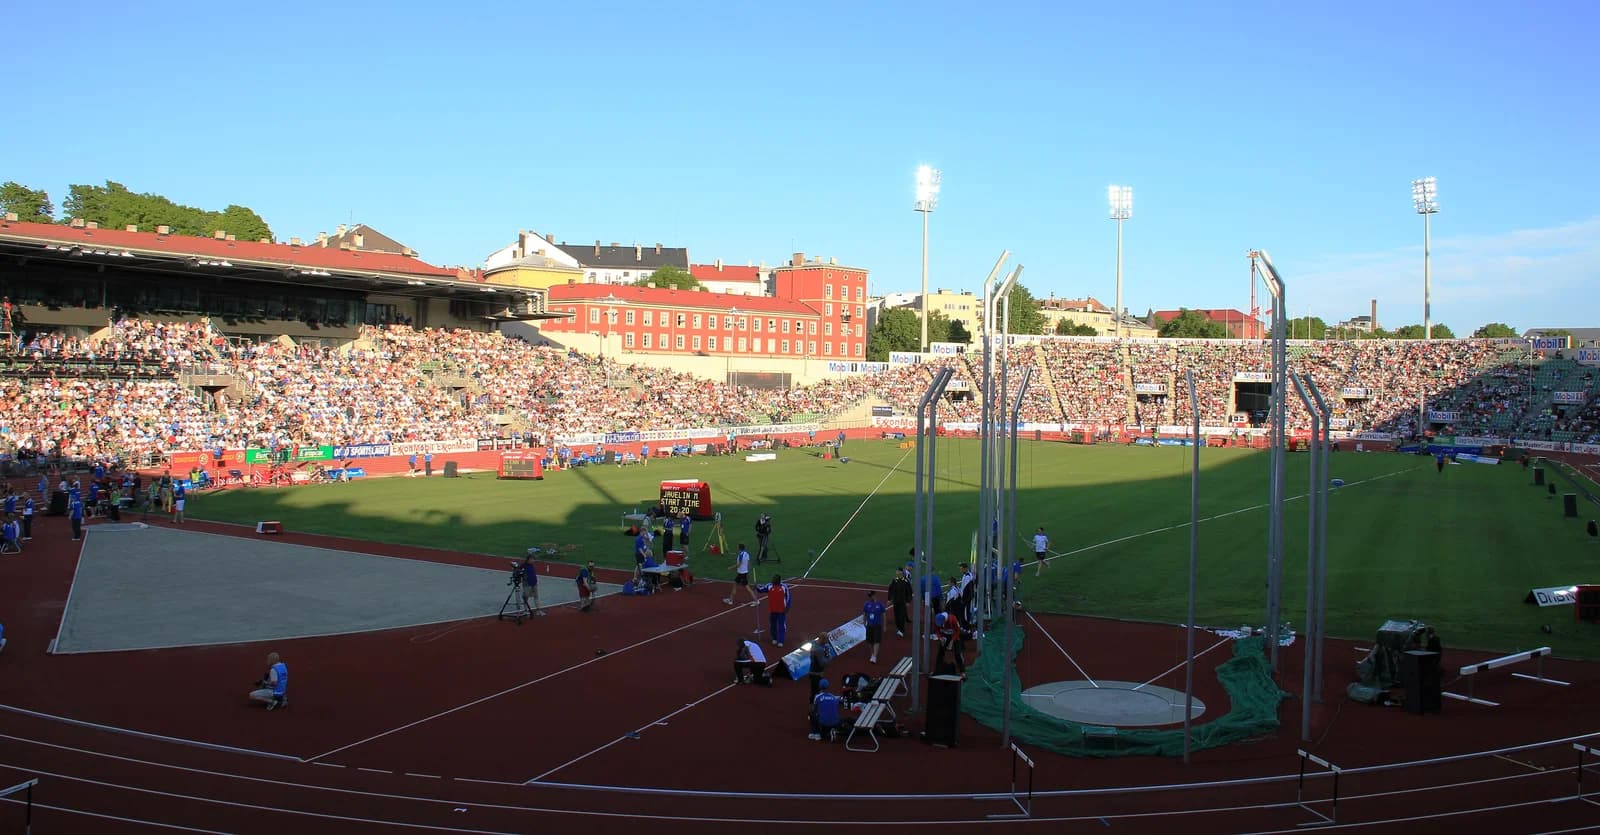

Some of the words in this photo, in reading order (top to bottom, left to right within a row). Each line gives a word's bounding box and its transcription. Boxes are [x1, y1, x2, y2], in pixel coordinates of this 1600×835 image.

[1533, 338, 1557, 349] Mobil
[933, 345, 956, 354] Mobil
[892, 354, 914, 364] Mobil
[829, 362, 850, 372] Mobil
[860, 363, 880, 373] Mobil
[1344, 388, 1366, 396] Mobil
[1430, 411, 1451, 421] Mobil
[392, 443, 433, 455] ExxonMobil
[437, 440, 475, 453] ExxonMobil
[663, 491, 690, 499] JAVELIN
[693, 492, 699, 500] M
[660, 498, 680, 506] START
[684, 499, 700, 507] TIME
